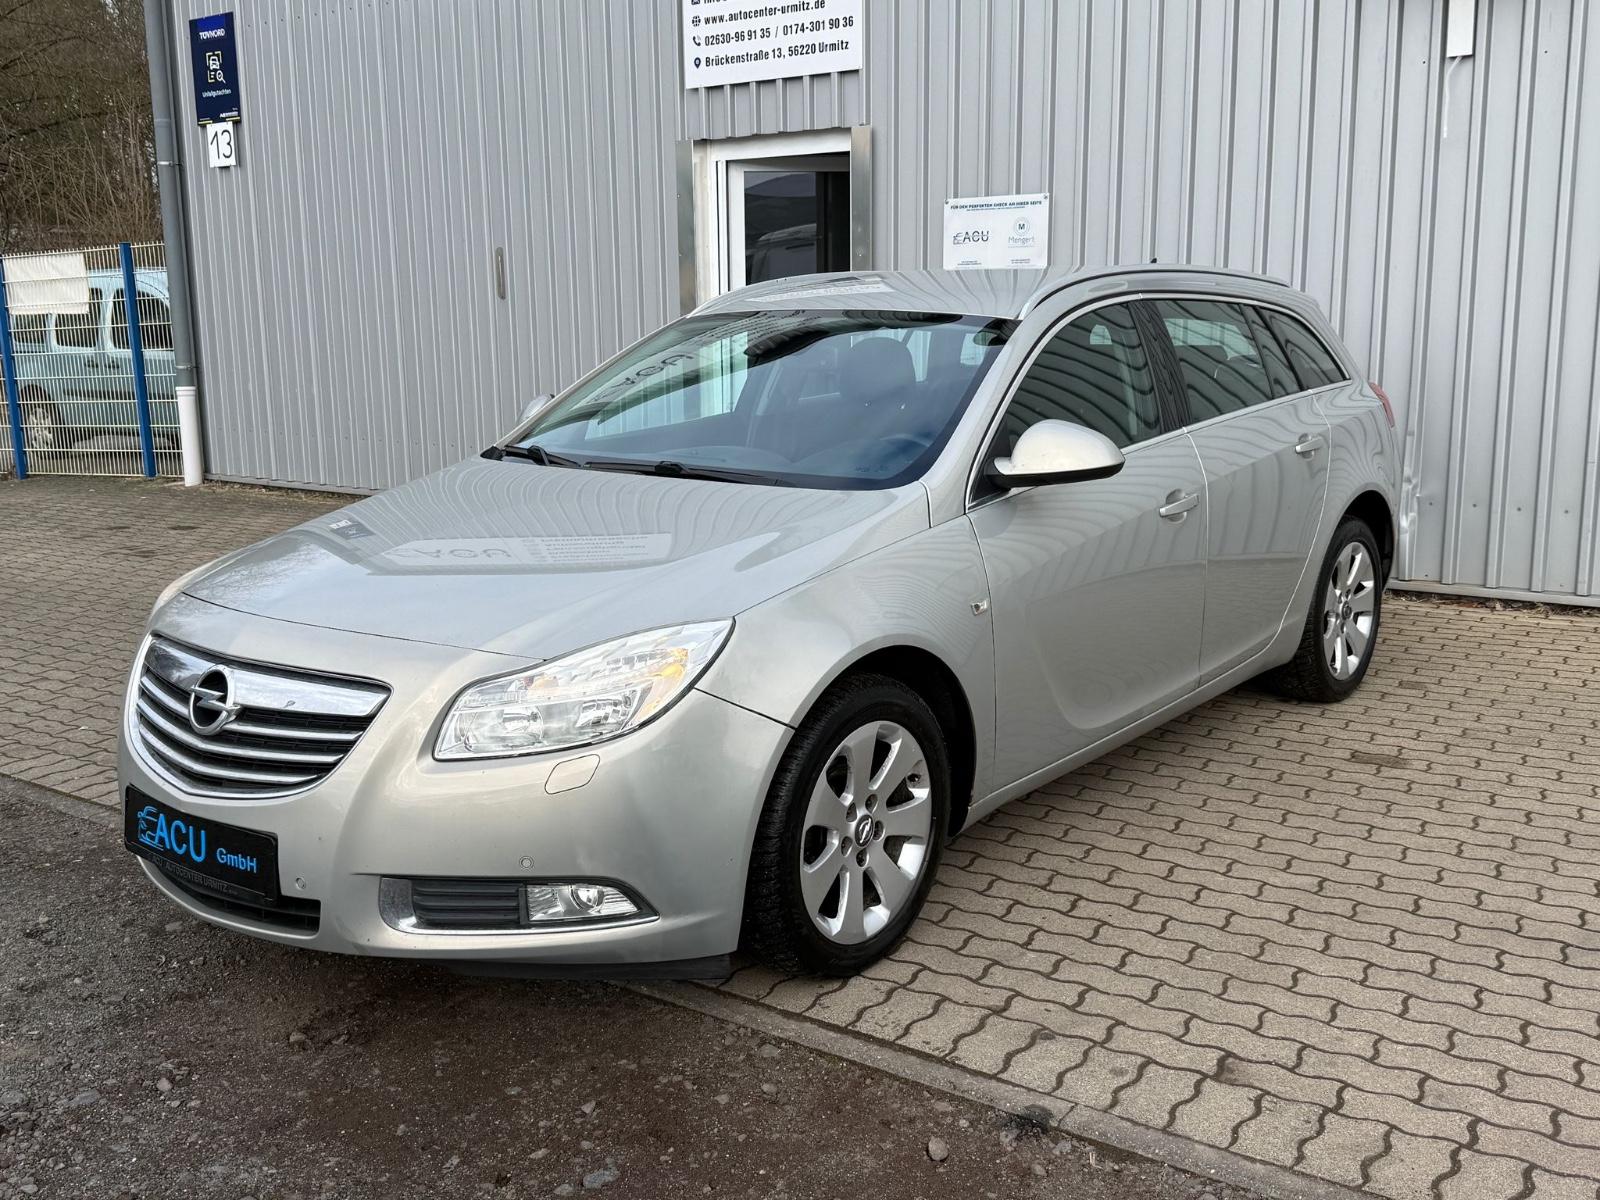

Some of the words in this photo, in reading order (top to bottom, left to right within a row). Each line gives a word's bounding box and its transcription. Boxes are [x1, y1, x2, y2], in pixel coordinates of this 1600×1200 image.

[704, 0, 826, 25] www.autocenter-urmitz.de
[704, 31, 746, 47] 02630-96
[747, 29, 757, 41] 91
[760, 27, 771, 39] 35
[783, 20, 825, 36] 0174-301
[829, 18, 840, 30] 90
[842, 16, 854, 28] 36
[705, 50, 770, 67] Brückenstraße
[771, 47, 786, 60] 13,
[788, 43, 816, 57] 56220
[818, 40, 849, 53] Urmitz
[210, 129, 233, 159] 13
[155, 813, 206, 863] ACU
[216, 847, 257, 874] GmbH
